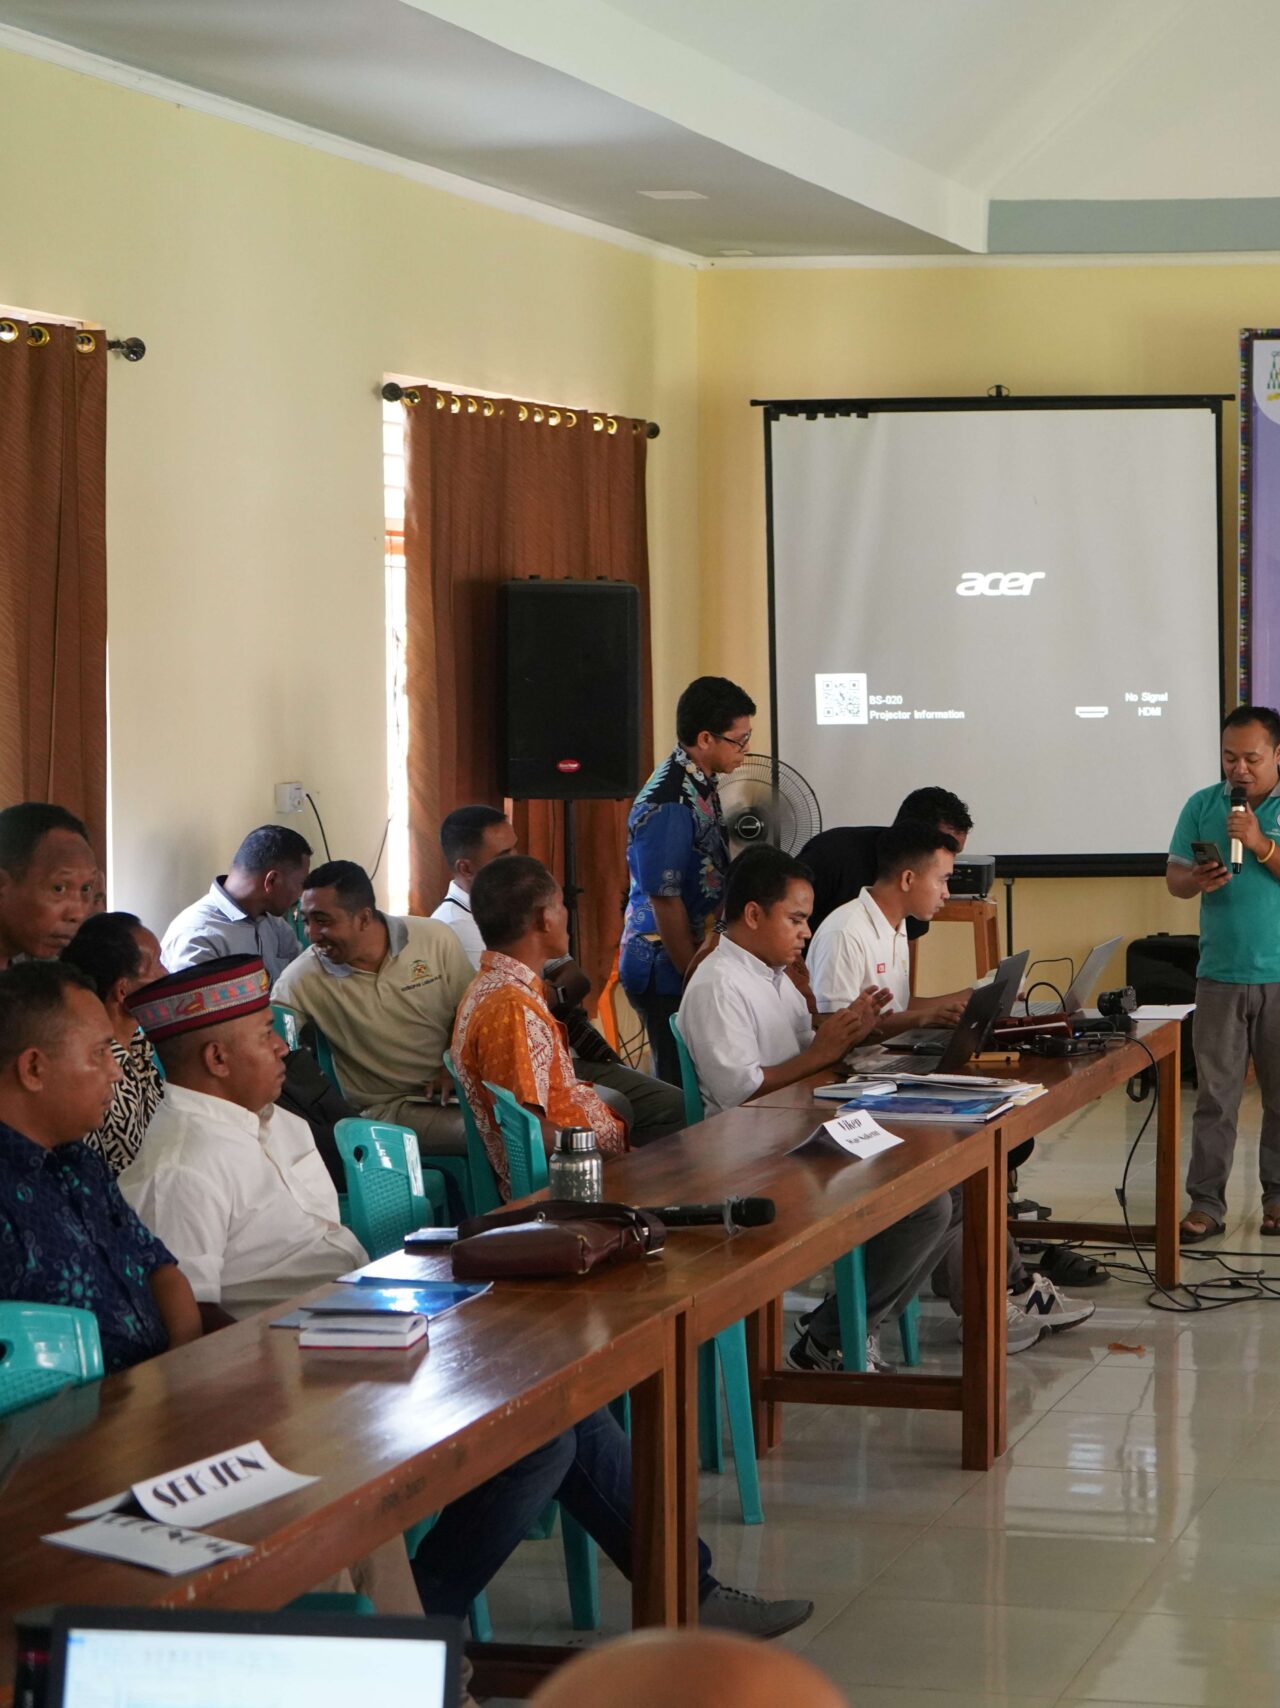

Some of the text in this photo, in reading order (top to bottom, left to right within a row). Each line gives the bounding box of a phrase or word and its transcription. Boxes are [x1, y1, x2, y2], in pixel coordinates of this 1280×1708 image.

[956, 571, 1046, 596] acer
[1125, 691, 1169, 704] No Signal
[869, 709, 965, 721] Projector Information
[1138, 707, 1162, 717] HDMI
[152, 1450, 266, 1508] SEKJEN
